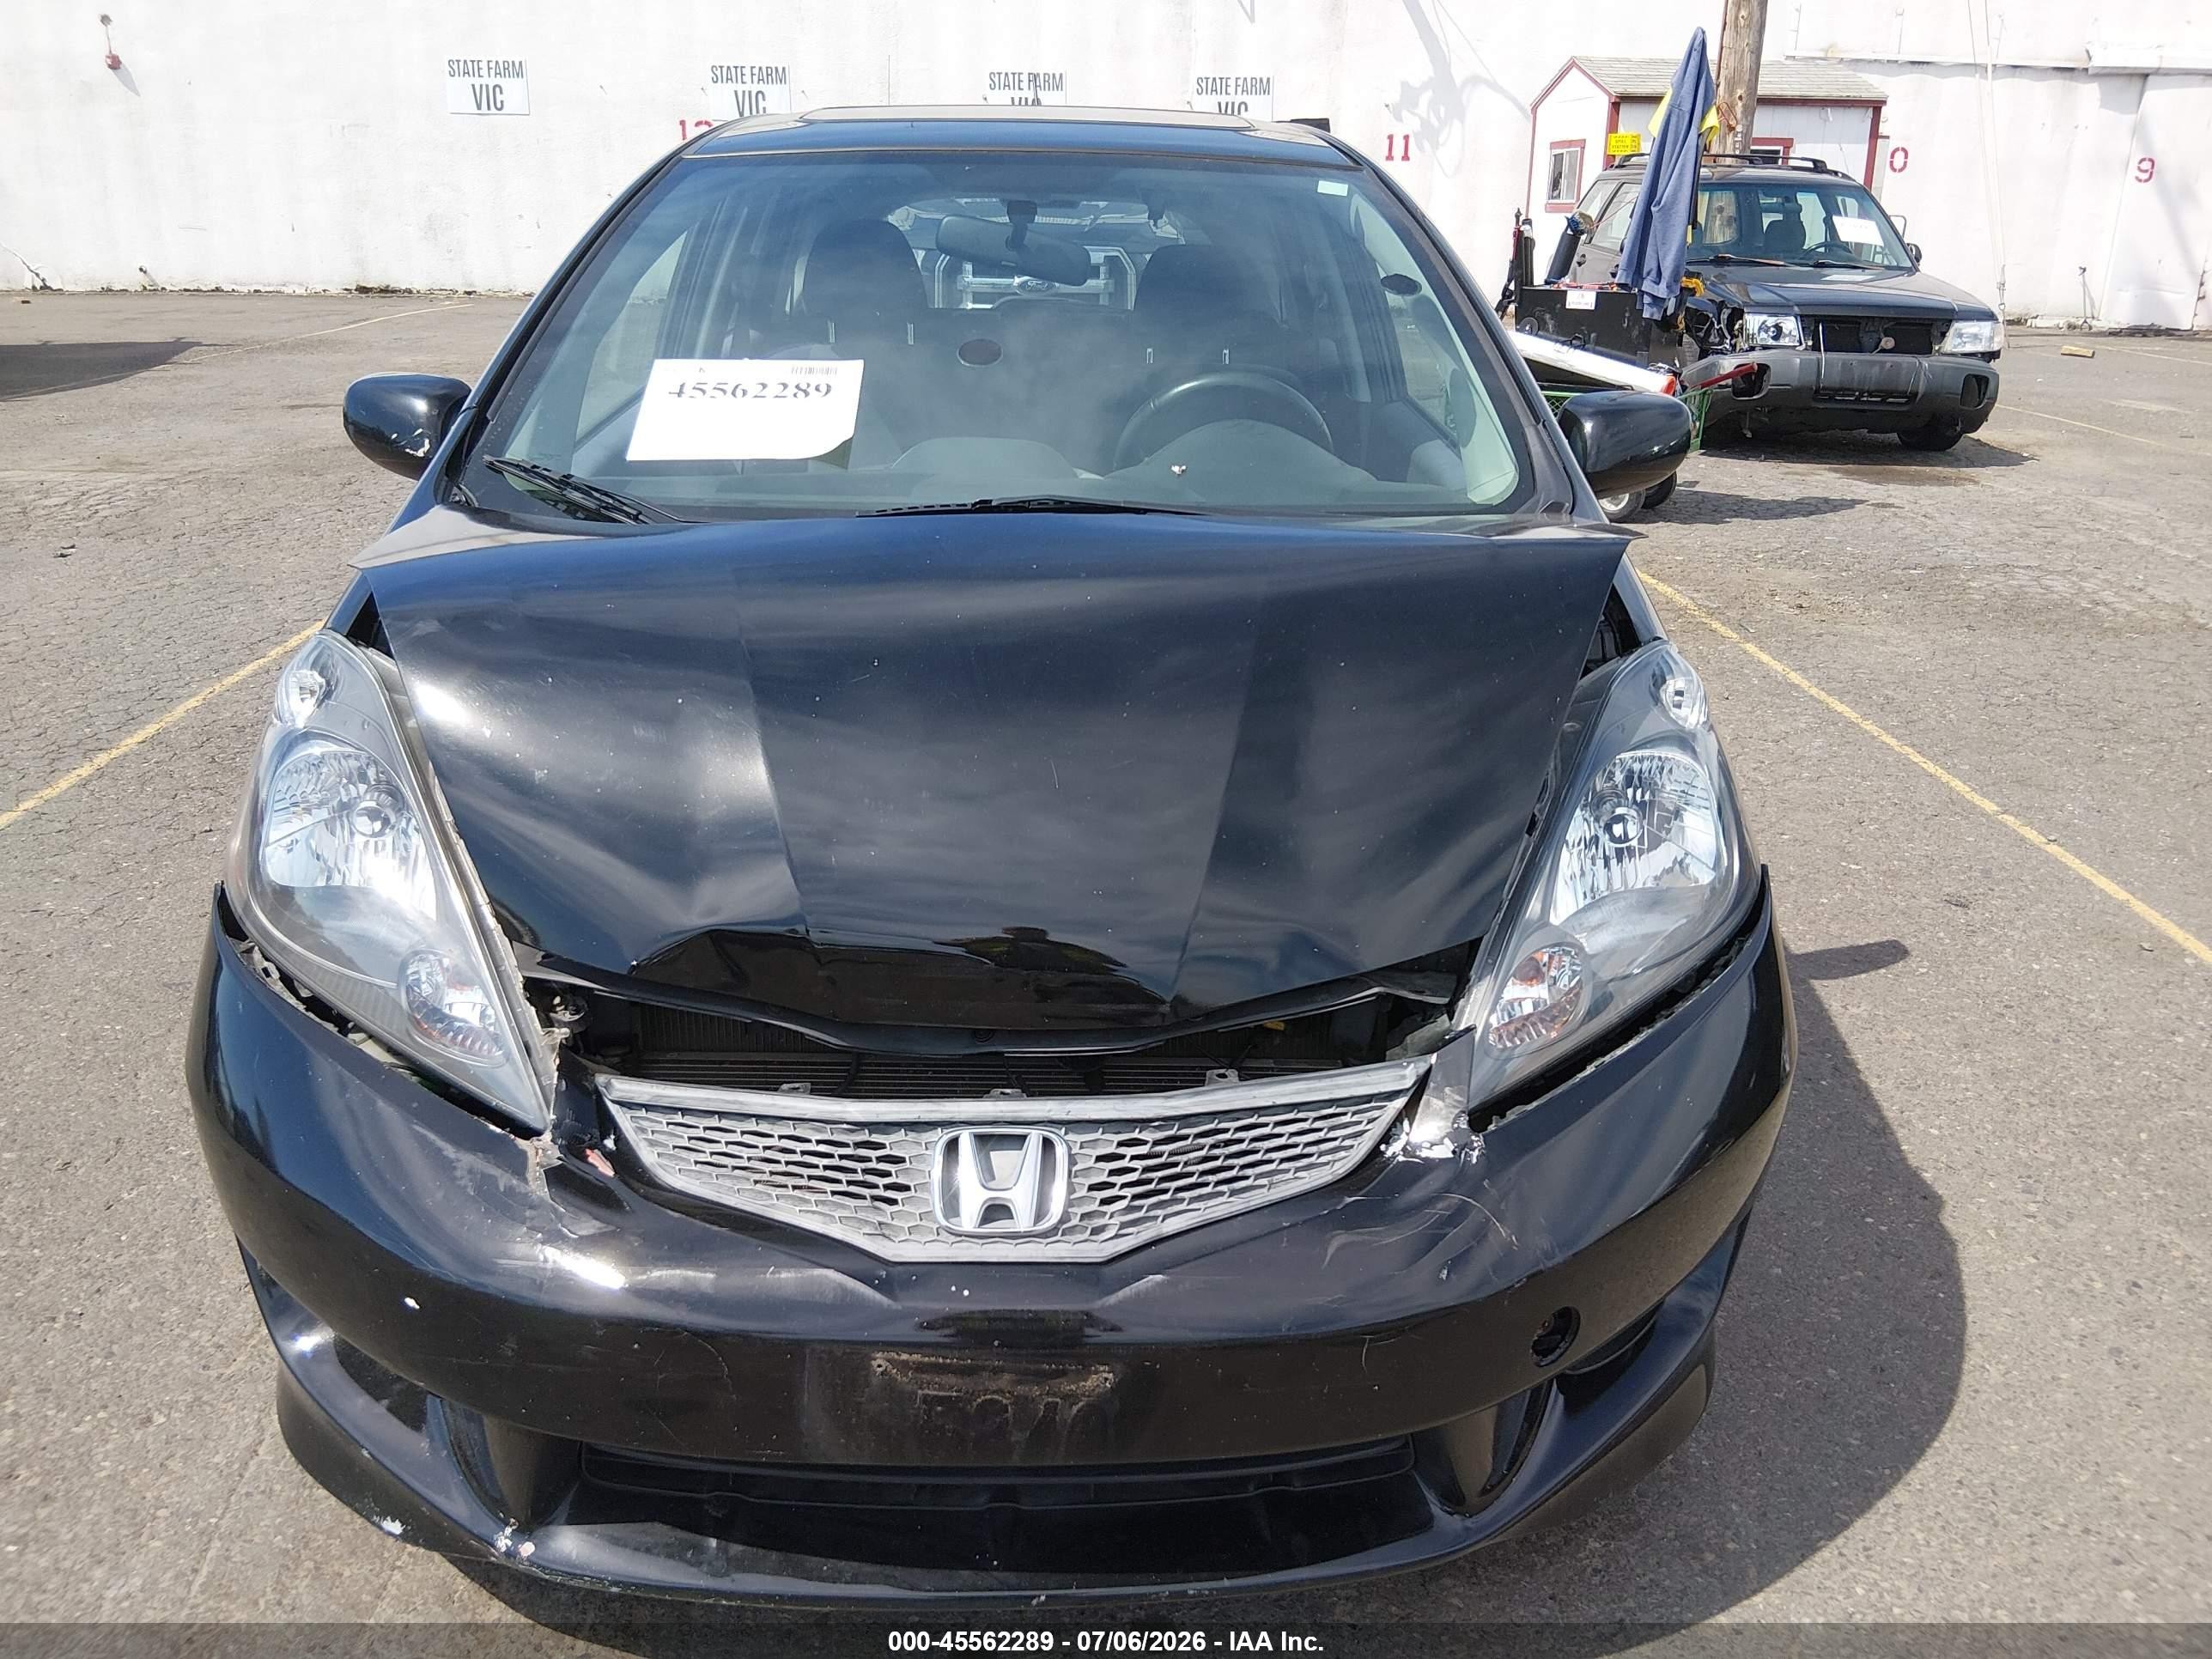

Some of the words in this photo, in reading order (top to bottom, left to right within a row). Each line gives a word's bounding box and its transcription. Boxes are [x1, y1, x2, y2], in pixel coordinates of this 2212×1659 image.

[447, 59, 484, 78] STATE
[487, 60, 524, 79] FARM
[711, 64, 747, 85] STATE
[750, 65, 787, 86] FARM
[988, 71, 1024, 91] STATE
[1027, 71, 1064, 92] FARM
[1196, 76, 1231, 96] STATE
[1235, 76, 1271, 96] FARM
[471, 83, 504, 112] VIC
[733, 89, 766, 118] VIC
[1385, 133, 1410, 161] 11
[2135, 157, 2155, 184] 9
[669, 382, 832, 399] 45562289
